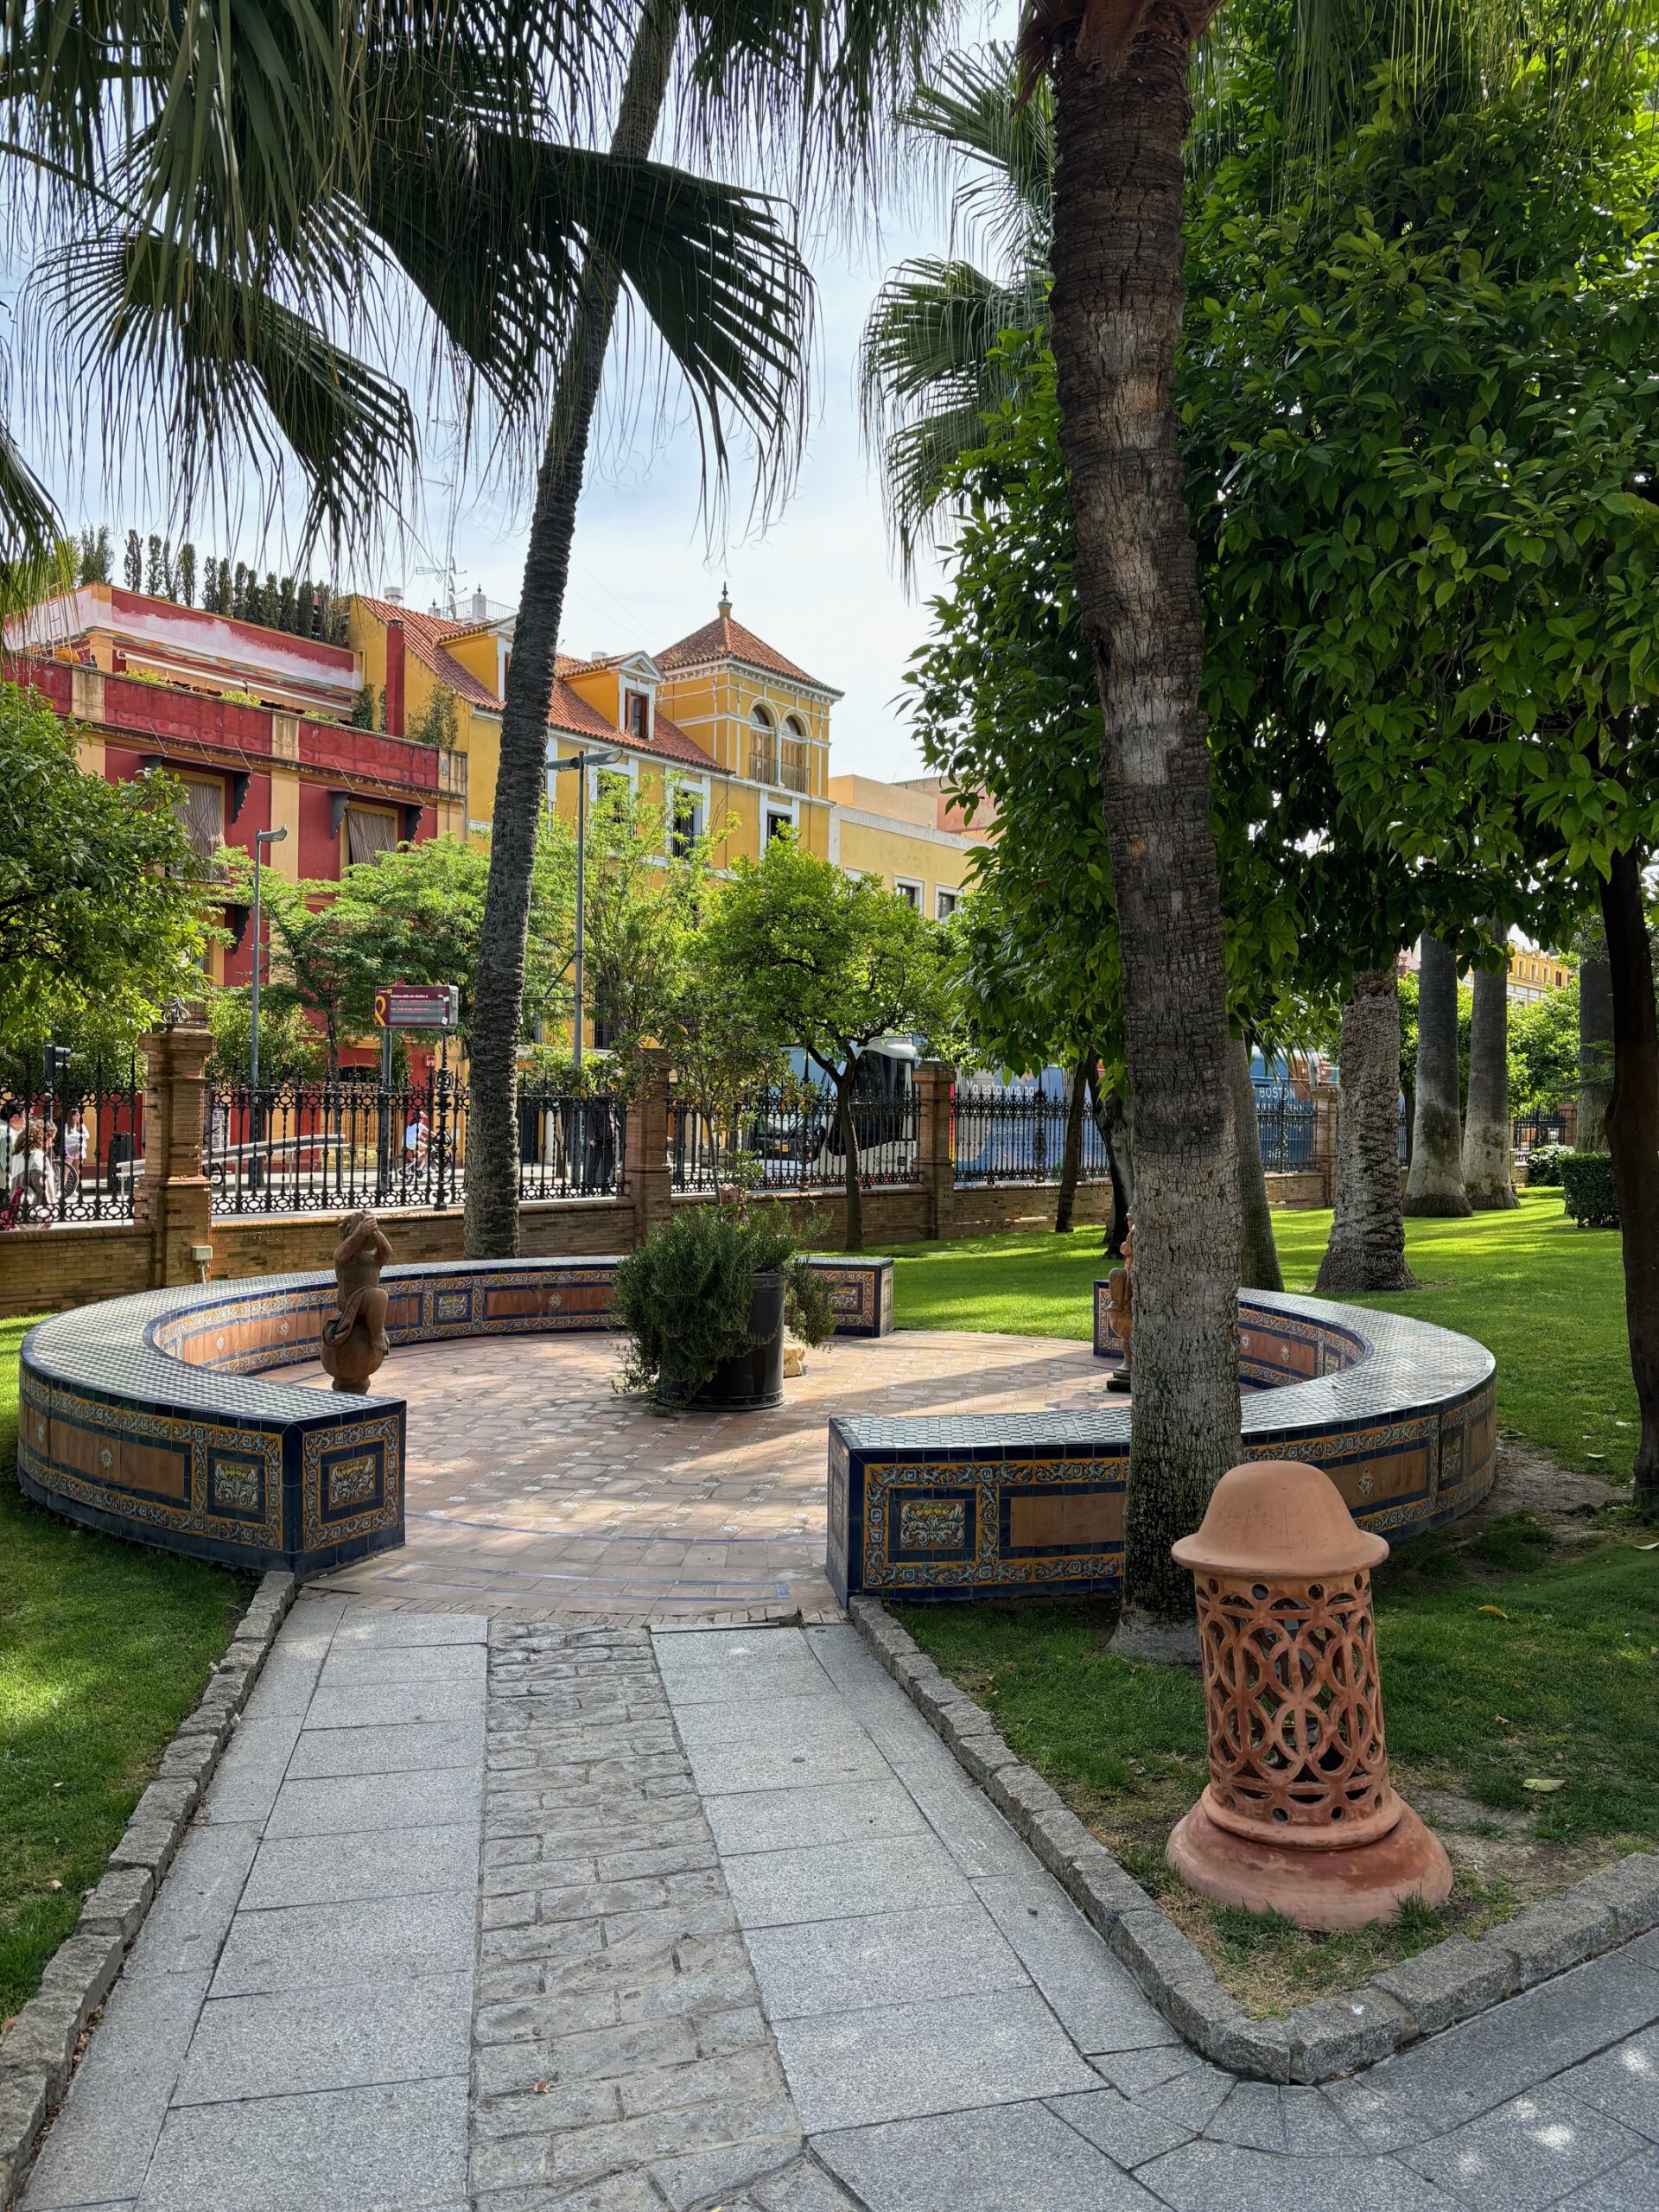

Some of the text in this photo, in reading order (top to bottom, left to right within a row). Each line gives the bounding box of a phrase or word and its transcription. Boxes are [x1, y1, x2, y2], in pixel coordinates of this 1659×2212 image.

[966, 1080, 979, 1094] Ya
[982, 1081, 1020, 1096] estamos
[1260, 1087, 1295, 1099] BOSTON
